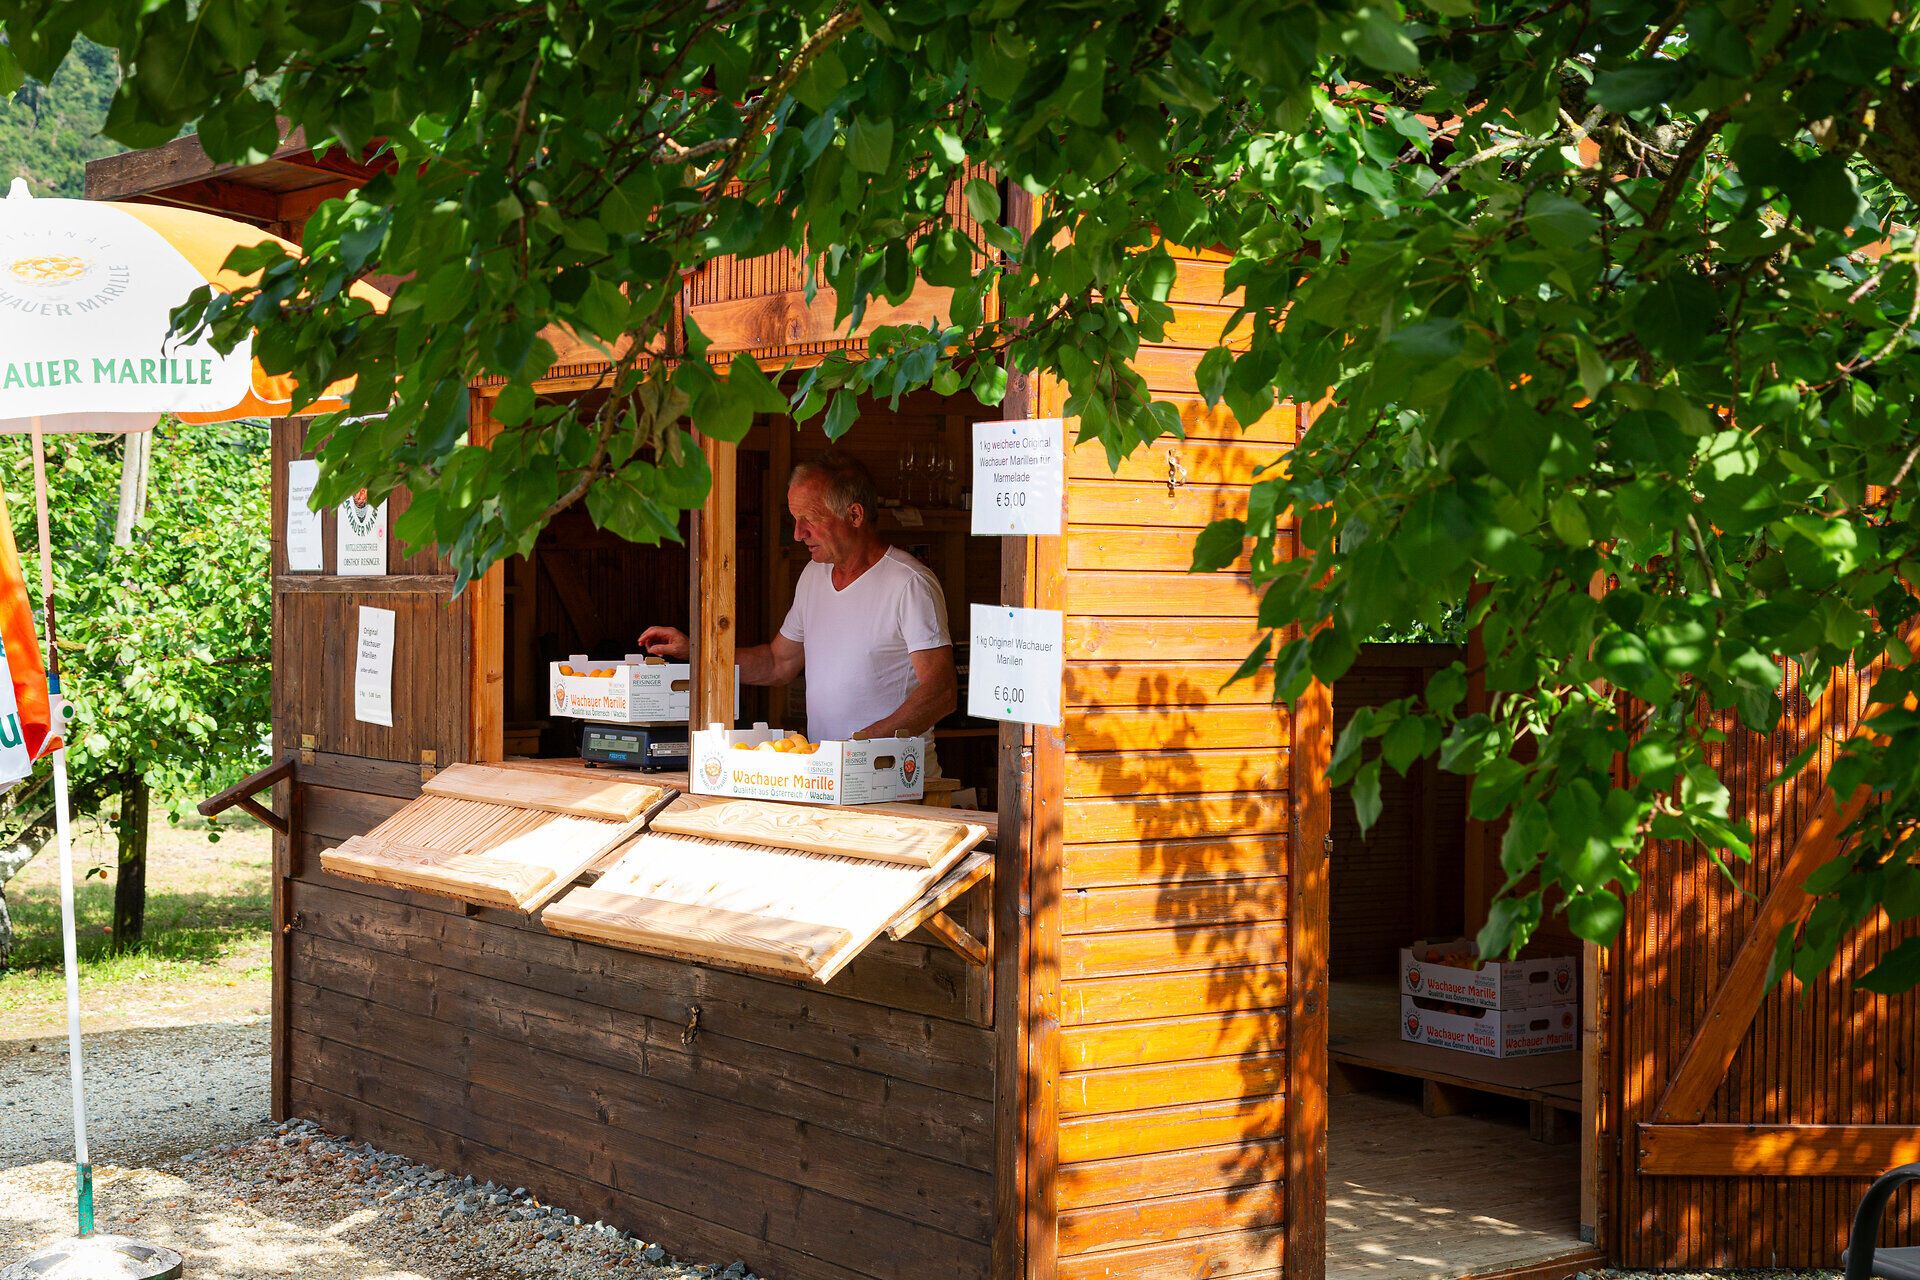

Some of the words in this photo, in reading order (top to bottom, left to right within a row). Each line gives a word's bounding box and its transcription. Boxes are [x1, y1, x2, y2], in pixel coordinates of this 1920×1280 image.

[0, 288, 72, 316] HAUER
[76, 264, 130, 313] MARILLE
[92, 357, 213, 386] MARILLE
[983, 440, 991, 452] kg
[992, 439, 1020, 451] weichere
[1022, 437, 1051, 451] Original
[980, 456, 1009, 467] Wachauer
[1010, 455, 1038, 466] Marillen
[993, 472, 1031, 483] Marmelade
[996, 492, 1002, 507] €
[1004, 491, 1026, 509] 5,00
[980, 636, 988, 648] kg
[988, 636, 1014, 649] Original
[1015, 638, 1053, 652] Wachauer
[996, 654, 1024, 666] Marillen
[570, 694, 601, 708] Wachauer
[603, 696, 626, 709] Marille
[994, 685, 1001, 700] €
[1002, 686, 1025, 703] 6,00
[732, 769, 789, 788] Wachauer
[793, 774, 835, 791] Marille
[733, 785, 757, 795] Qualität
[758, 788, 769, 796] aus
[770, 787, 803, 799] Österreich
[809, 791, 835, 801] Wachau
[1427, 978, 1466, 994] Wachauer
[1468, 984, 1496, 1000] Marille
[1426, 1025, 1465, 1042] Wachauer
[1467, 1032, 1495, 1047] Marille
[1505, 1036, 1544, 1049] Wachauer
[1546, 1031, 1574, 1044] Marille
